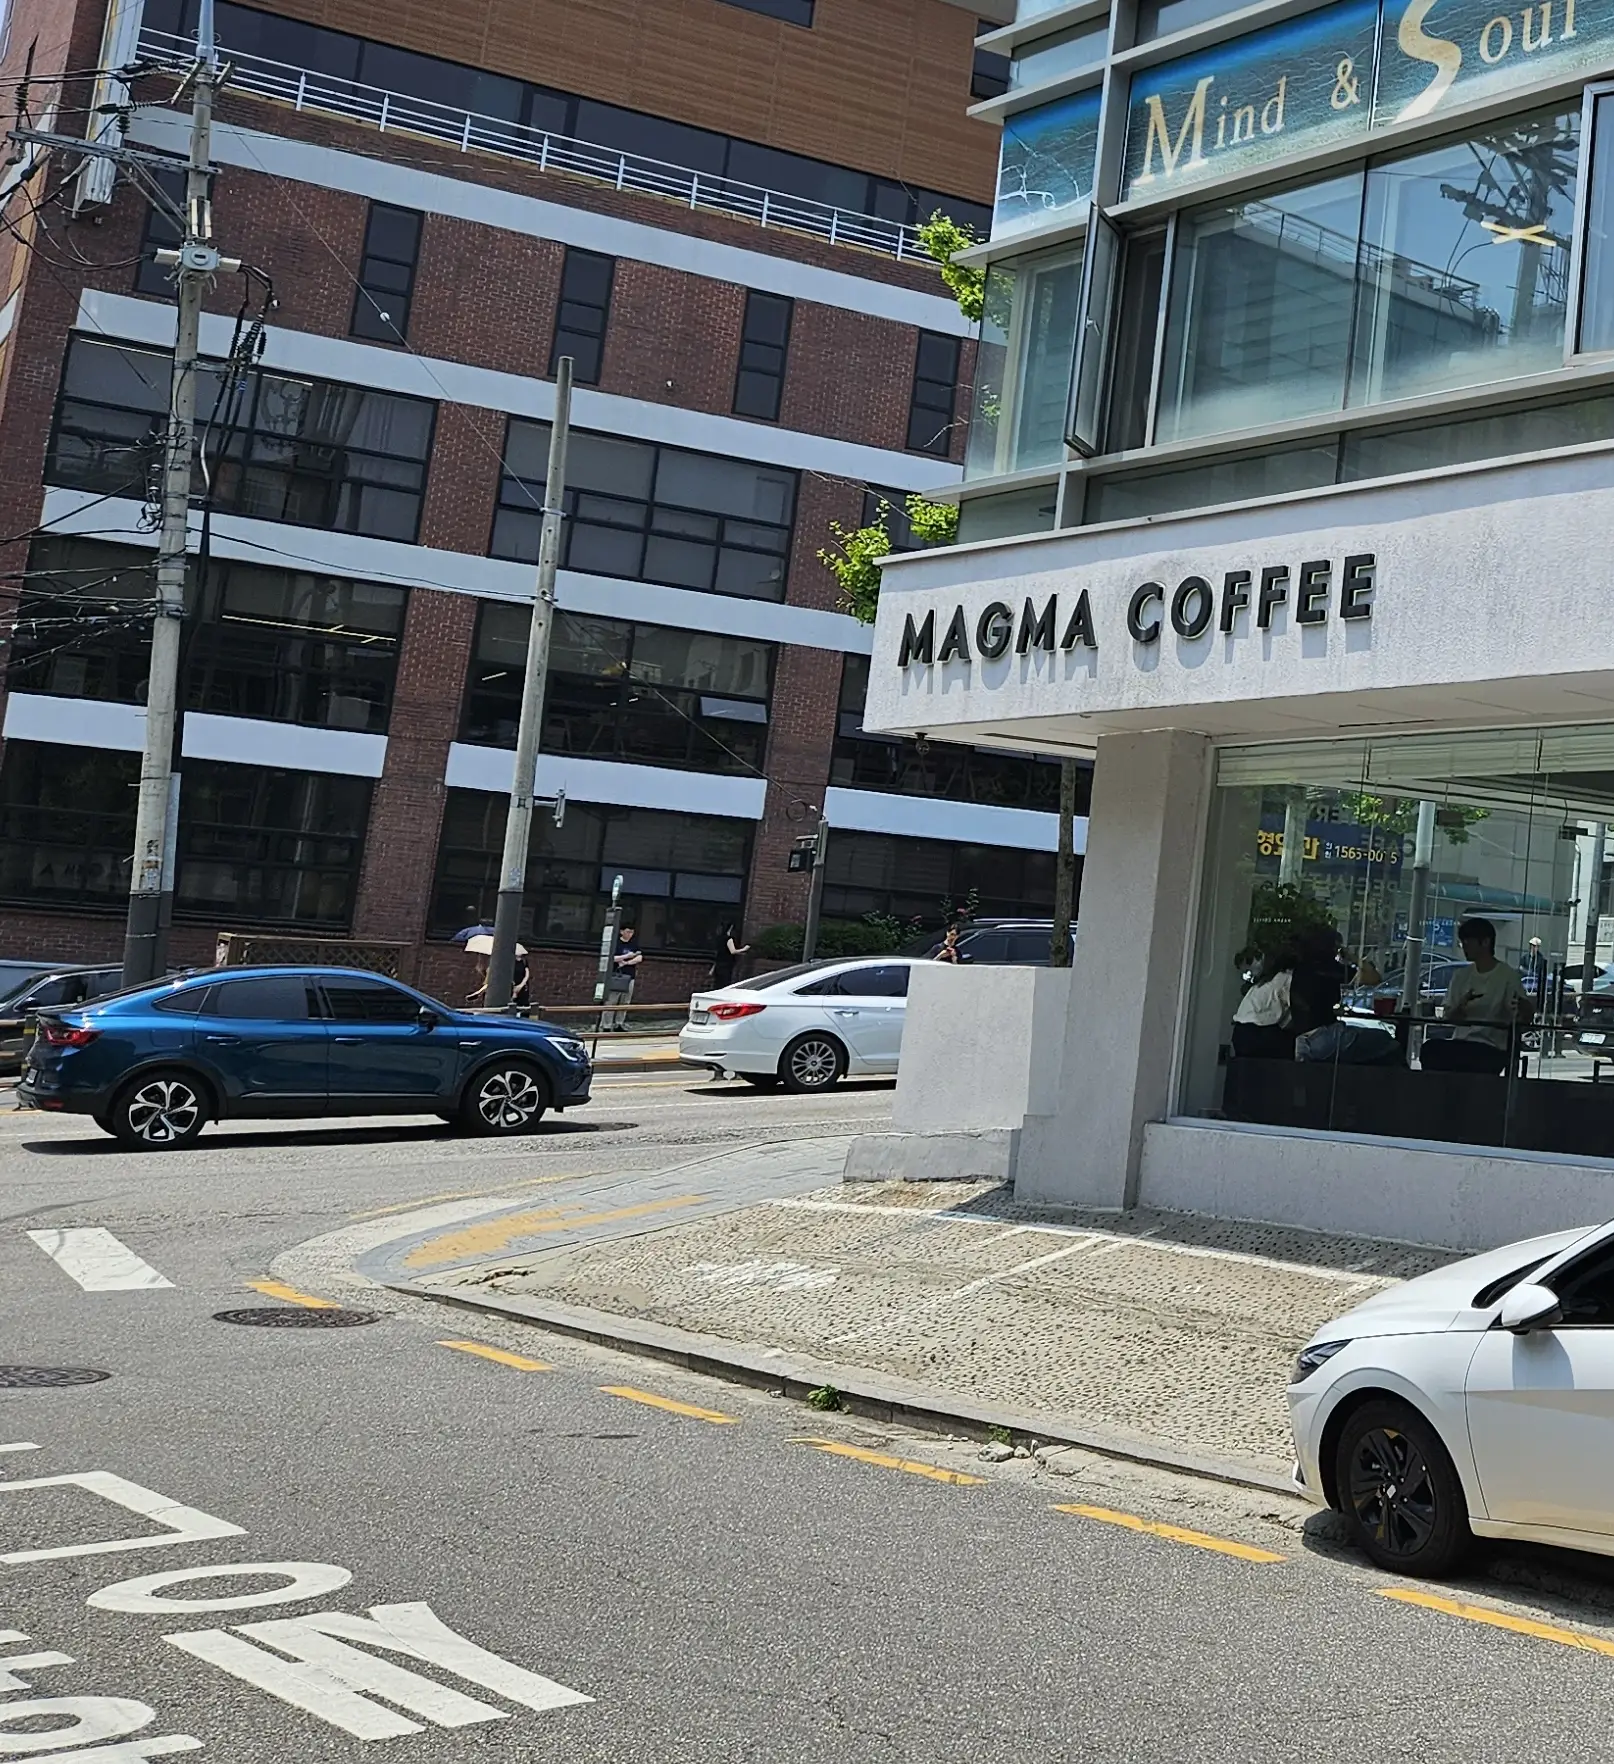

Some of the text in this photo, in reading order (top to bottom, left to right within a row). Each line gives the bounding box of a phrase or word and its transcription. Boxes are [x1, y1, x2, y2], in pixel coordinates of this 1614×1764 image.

[1129, 76, 1287, 187] Mind
[1330, 57, 1360, 110] &
[897, 553, 1376, 668] MAGMA COFFEE
